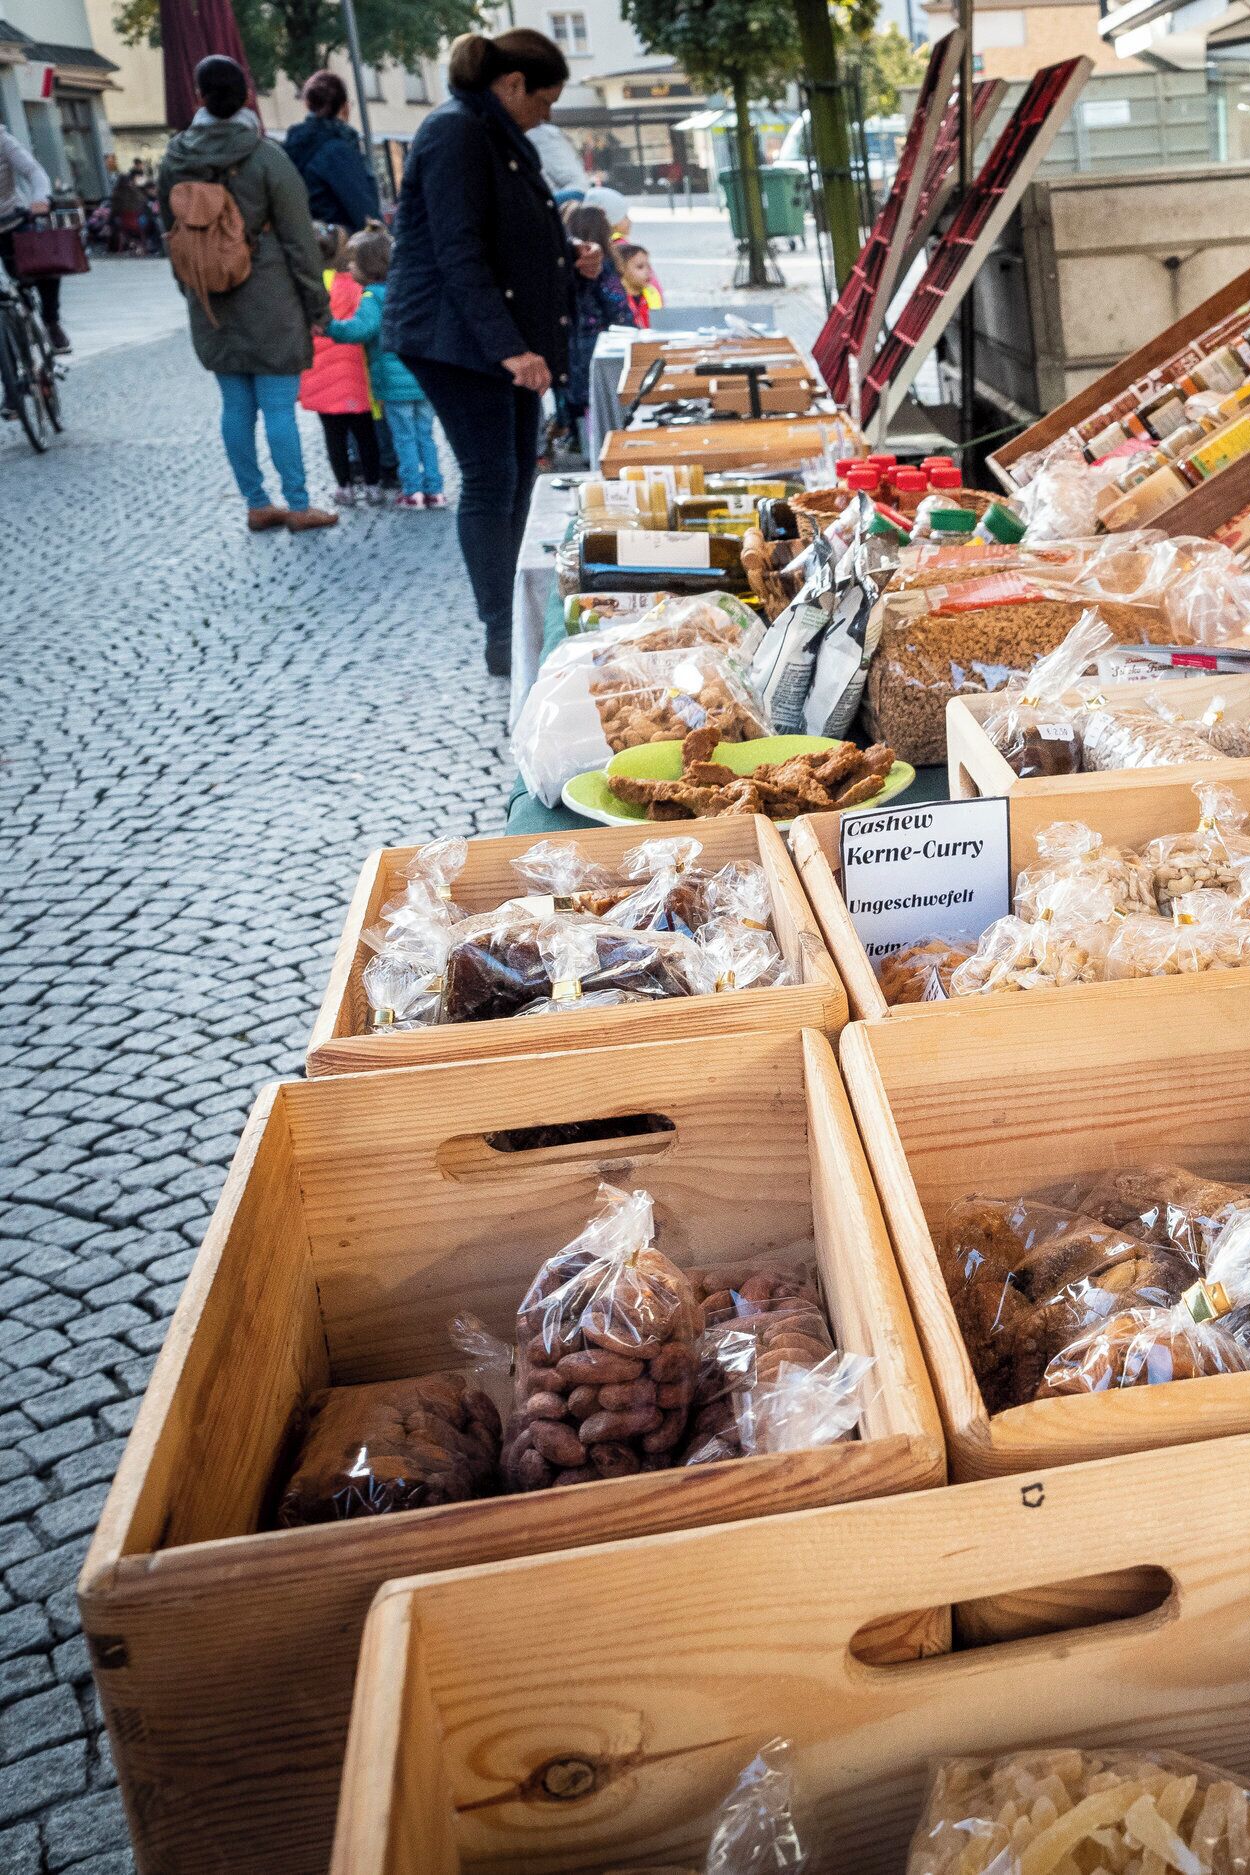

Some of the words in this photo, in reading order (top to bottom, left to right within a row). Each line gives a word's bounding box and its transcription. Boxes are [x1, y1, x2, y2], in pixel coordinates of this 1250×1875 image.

[846, 813, 934, 837] Cashew
[846, 839, 985, 866] Kerne-Curry
[849, 888, 976, 915] Ungeschwefelt
